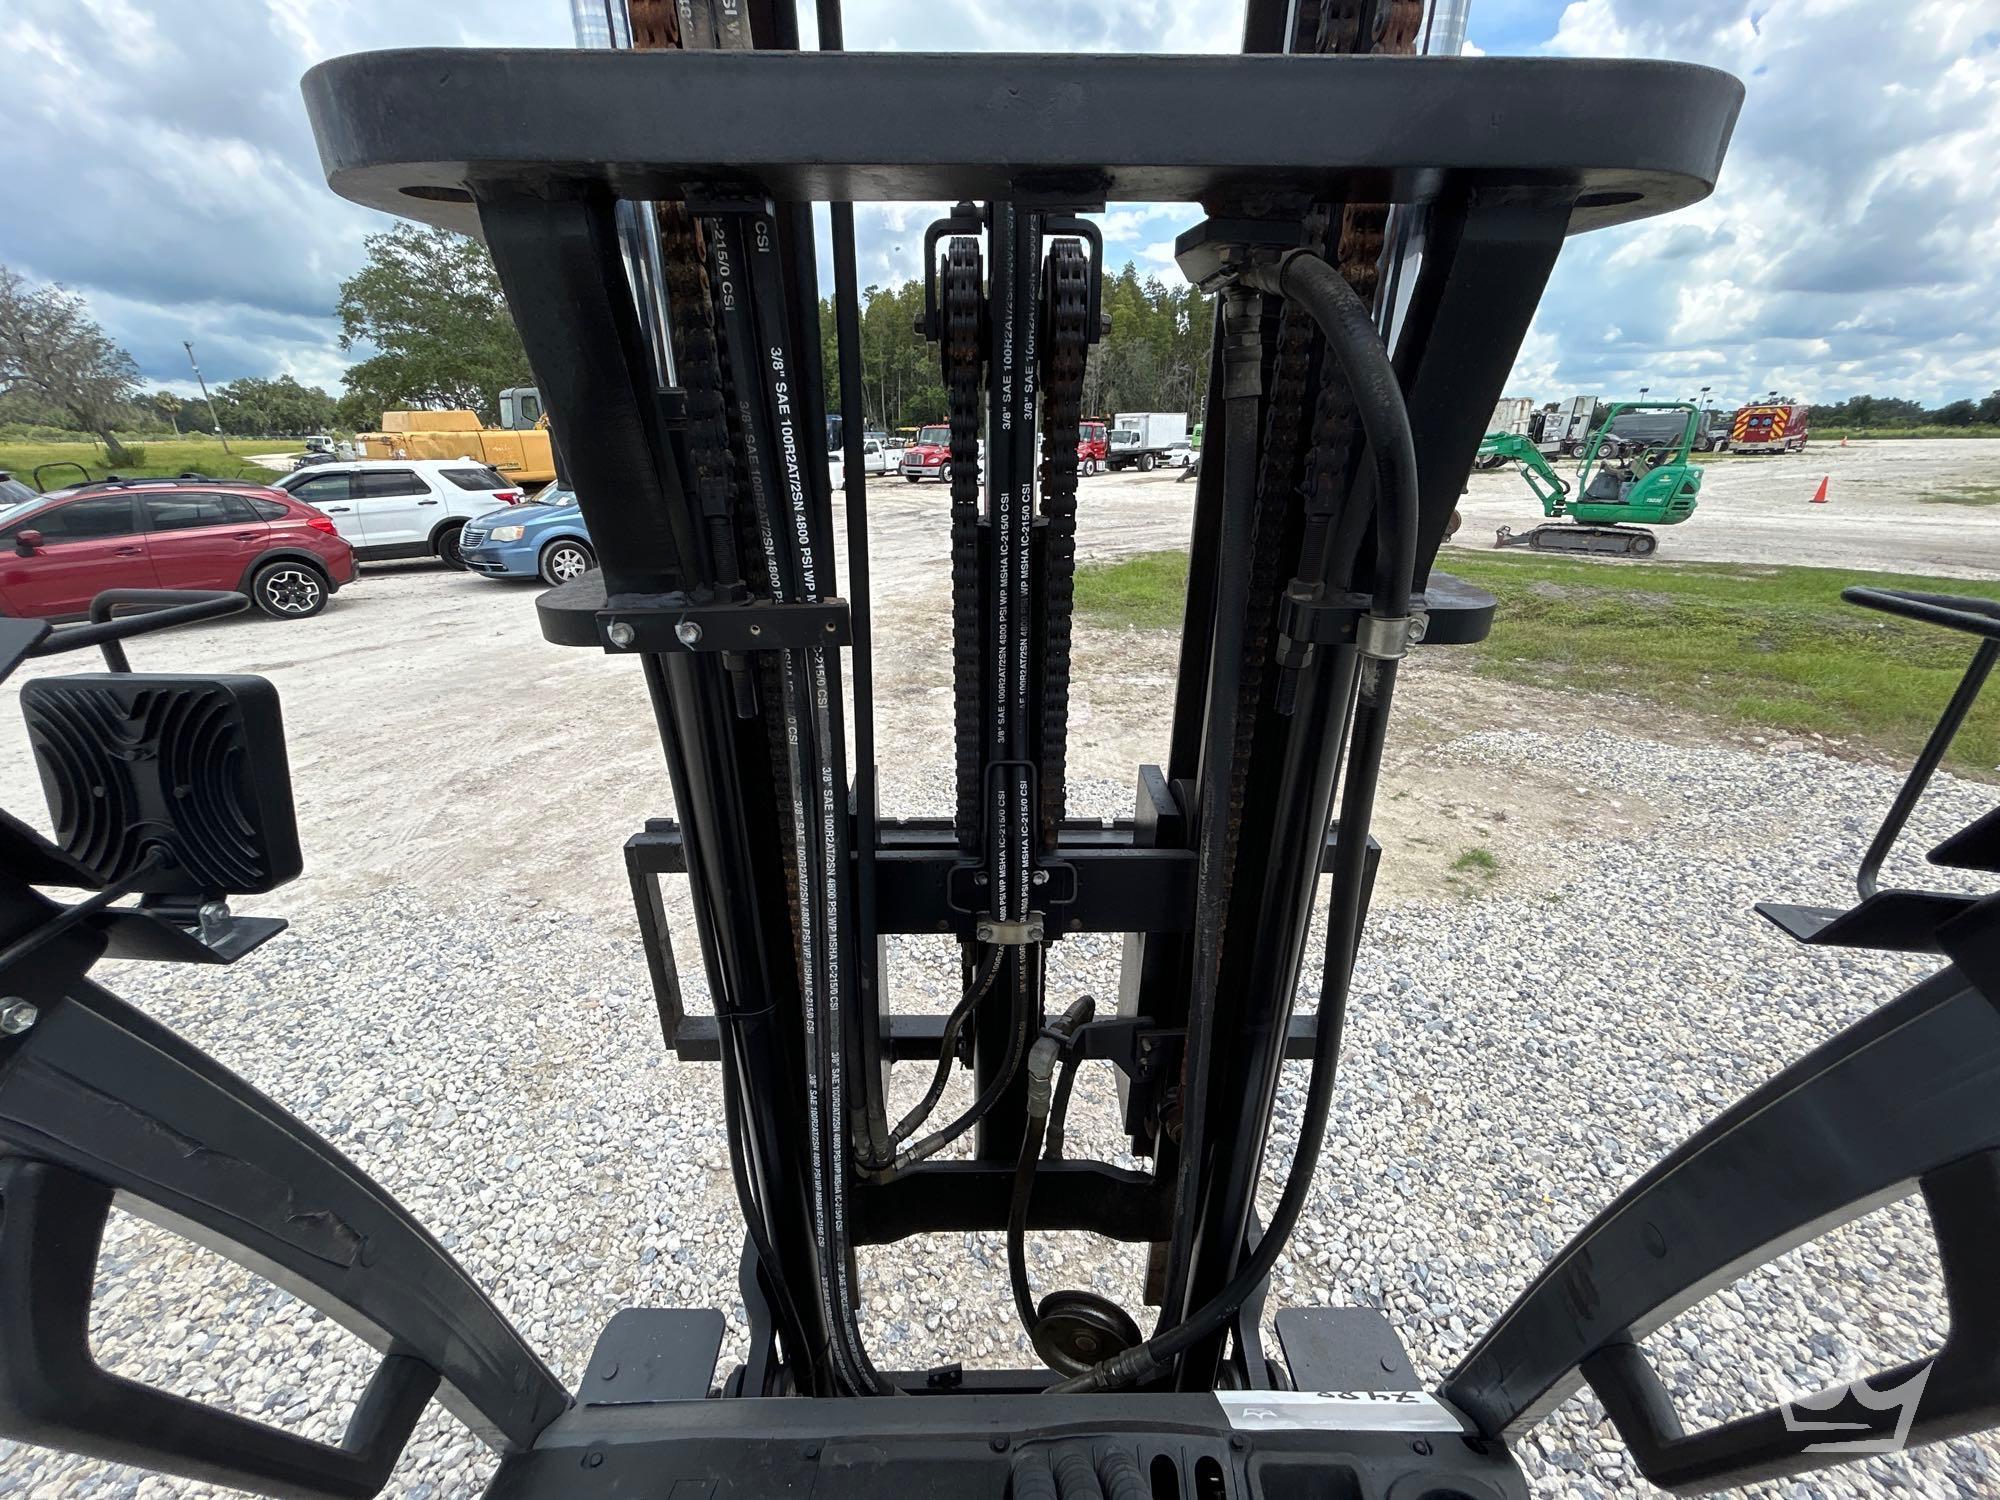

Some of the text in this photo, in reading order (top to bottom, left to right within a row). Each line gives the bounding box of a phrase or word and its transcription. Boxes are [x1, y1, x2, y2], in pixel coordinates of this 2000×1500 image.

[755, 220, 770, 252] CSI
[721, 281, 735, 311] CSI
[770, 346, 786, 378] 3/8"
[1002, 375, 1011, 402] SAE
[1024, 366, 1034, 393] SAE
[775, 382, 791, 415] SAE
[1024, 397, 1033, 421] 3/8"
[1002, 406, 1011, 430] 3/8"
[780, 419, 805, 511] 100R2AT/2SN
[1000, 492, 1010, 512] CSI
[1021, 483, 1031, 503] CSI
[796, 514, 810, 545] 4800
[1000, 514, 1009, 555] IC-215/0
[1021, 505, 1031, 546] IC-215/0
[800, 547, 814, 569] PSI
[1021, 548, 1029, 579] MSHA
[804, 570, 816, 592] WP
[1000, 557, 1009, 588] MSHA
[745, 434, 759, 464] SAE
[754, 470, 775, 556] 100R2AT/2SN
[768, 558, 781, 588] 4800
[788, 726, 799, 745] CSI
[999, 589, 1008, 606] WP
[1020, 580, 1029, 597] WP
[999, 606, 1008, 622] PSI
[999, 624, 1007, 645] 4800
[998, 647, 1007, 703] 100R2AT/2SN
[817, 689, 828, 709] CSI
[998, 705, 1006, 724] SAE
[823, 789, 833, 810] SAE
[998, 790, 1006, 807] CSI
[1020, 780, 1028, 797] CSI
[998, 809, 1006, 848] IC-215/0
[1020, 798, 1029, 837] IC-215/0
[795, 822, 805, 841] SAE
[824, 813, 836, 875] 100R2AT/2SN
[1020, 840, 1029, 868] MSHA
[796, 845, 809, 904] 100R2AT/2SN
[998, 850, 1007, 878] MSHA
[827, 877, 837, 900] 4800
[999, 880, 1007, 892] WP
[1020, 870, 1029, 884] WP
[801, 906, 810, 927] 4800
[828, 901, 837, 917] PSI
[802, 929, 811, 943] PSI
[828, 917, 838, 932] WP
[803, 944, 811, 959] WP
[829, 934, 838, 960] MSHA
[804, 960, 813, 984] MSHA
[829, 962, 839, 995] IC-215/0
[805, 986, 814, 1018] IC-215/0
[830, 996, 839, 1011] CSI
[806, 1020, 815, 1034] CSI
[832, 1069, 840, 1084] SAE
[809, 1089, 818, 1105] SAE
[835, 1221, 843, 1232] CSI
